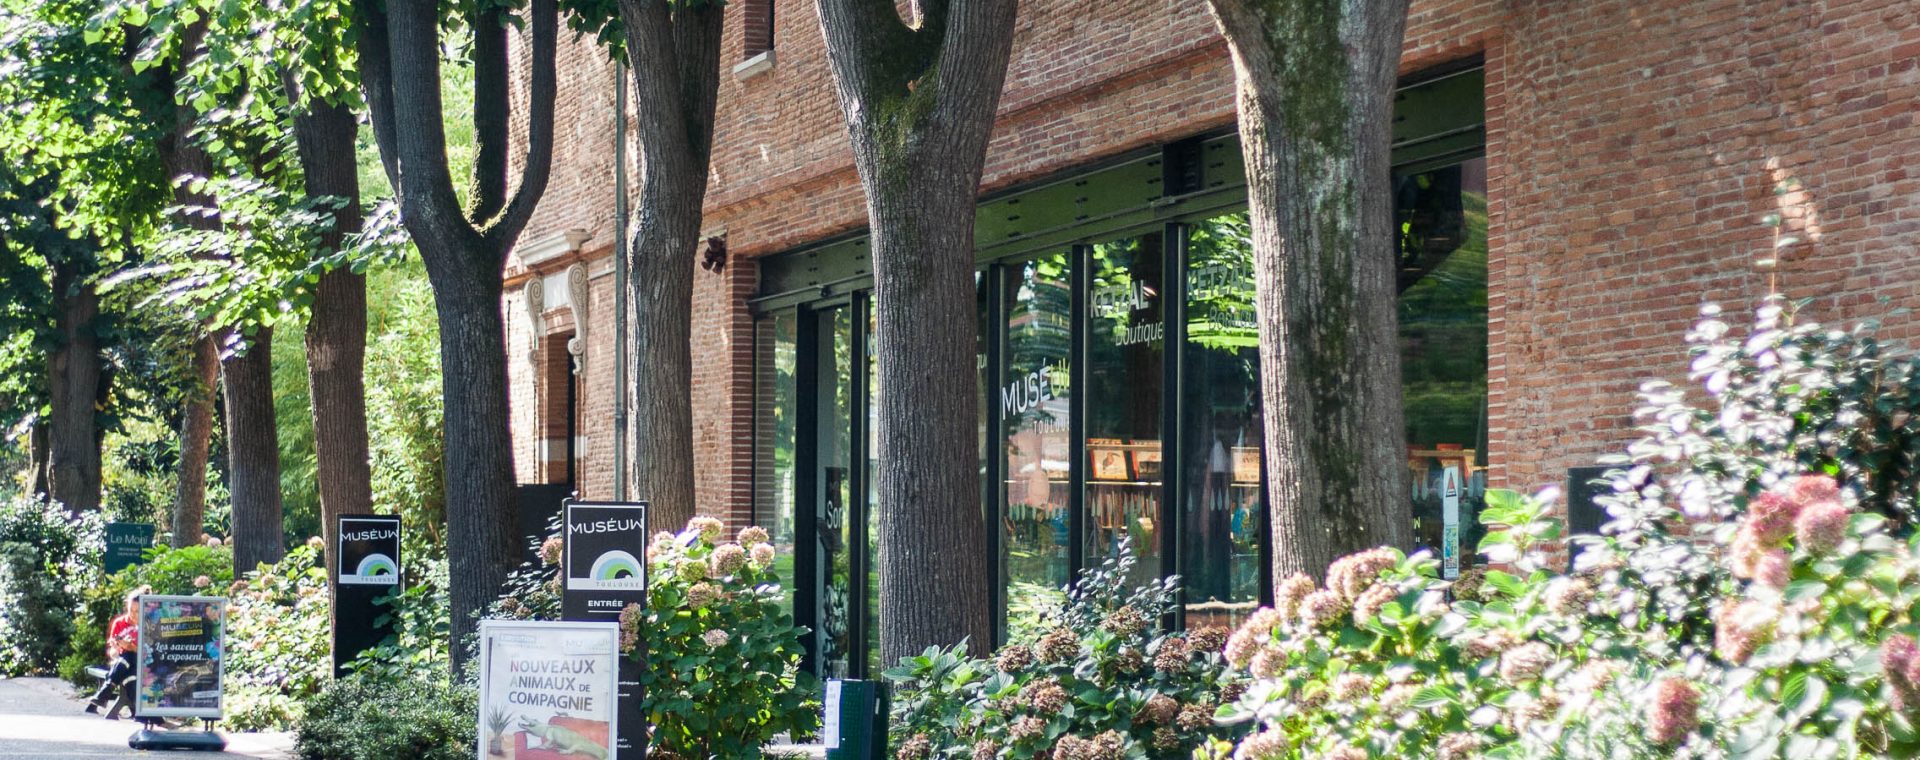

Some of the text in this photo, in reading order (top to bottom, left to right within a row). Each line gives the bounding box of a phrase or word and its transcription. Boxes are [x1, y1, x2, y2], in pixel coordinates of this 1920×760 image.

[1090, 279, 1149, 318] KETZAL
[1115, 318, 1163, 347] Boutique
[1033, 417, 1070, 435] TOULOU
[110, 534, 122, 544] Le
[588, 599, 623, 607] ENTRÉE
[155, 642, 204, 653] Les saveurs
[510, 660, 596, 674] NOUVEAUX
[509, 675, 592, 692] ANIMAUX DE
[508, 691, 593, 711] COMPAGNIE
